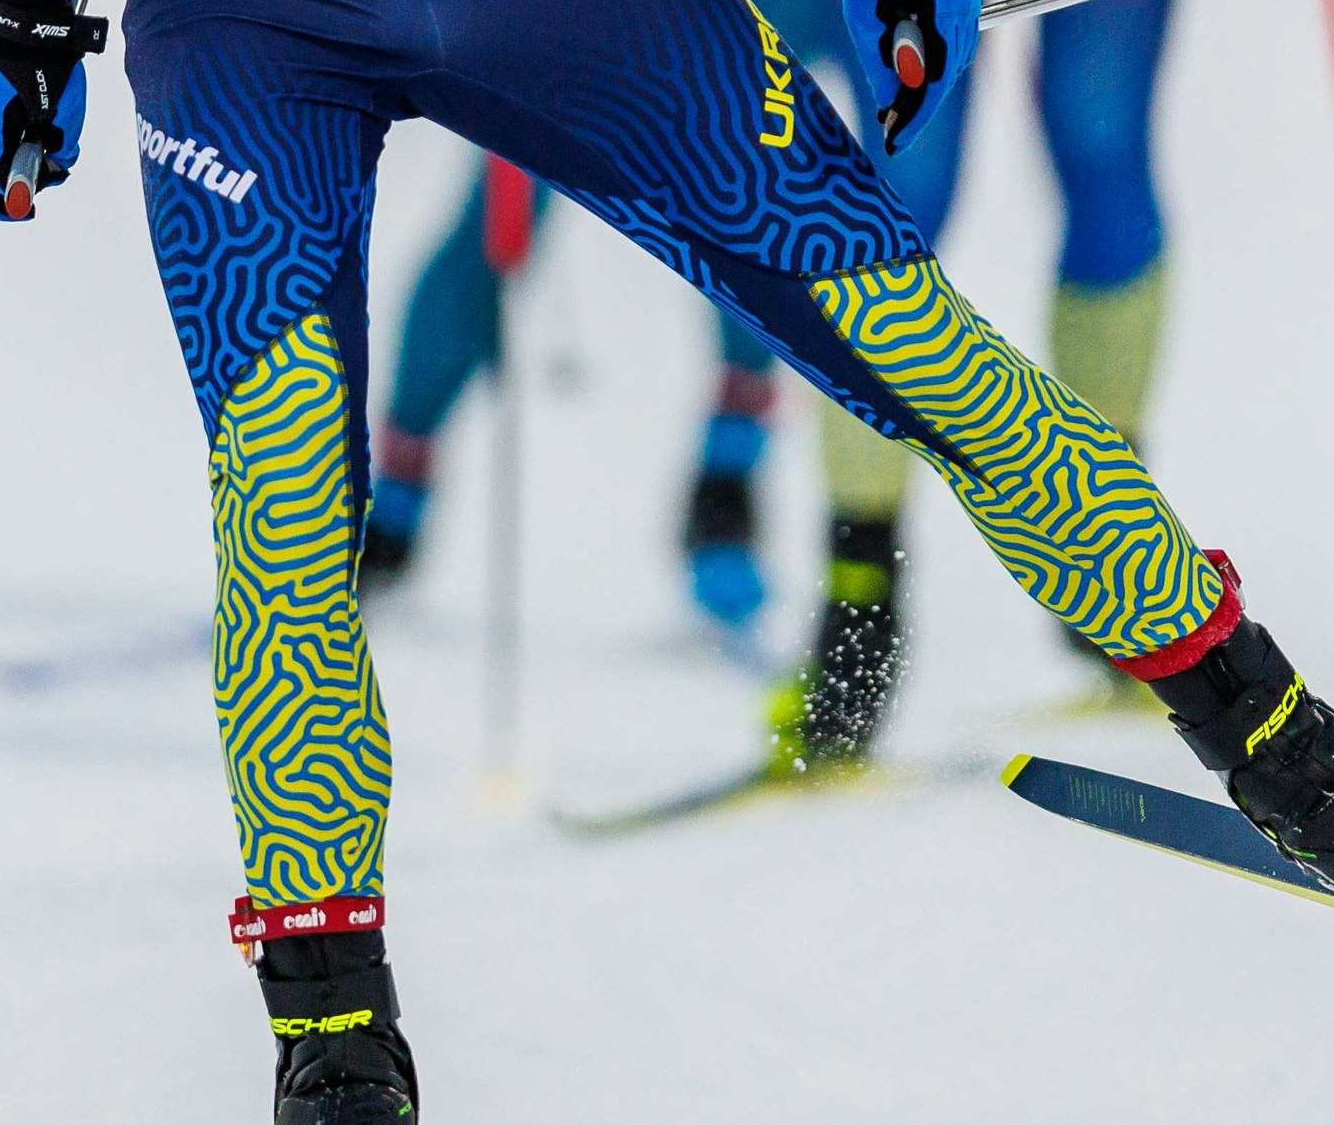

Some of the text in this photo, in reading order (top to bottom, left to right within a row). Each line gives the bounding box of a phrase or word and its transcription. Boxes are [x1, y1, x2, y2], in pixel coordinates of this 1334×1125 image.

[93, 29, 100, 40] R
[1246, 672, 1304, 757] FISCH
[270, 1009, 373, 1035] SCHER
